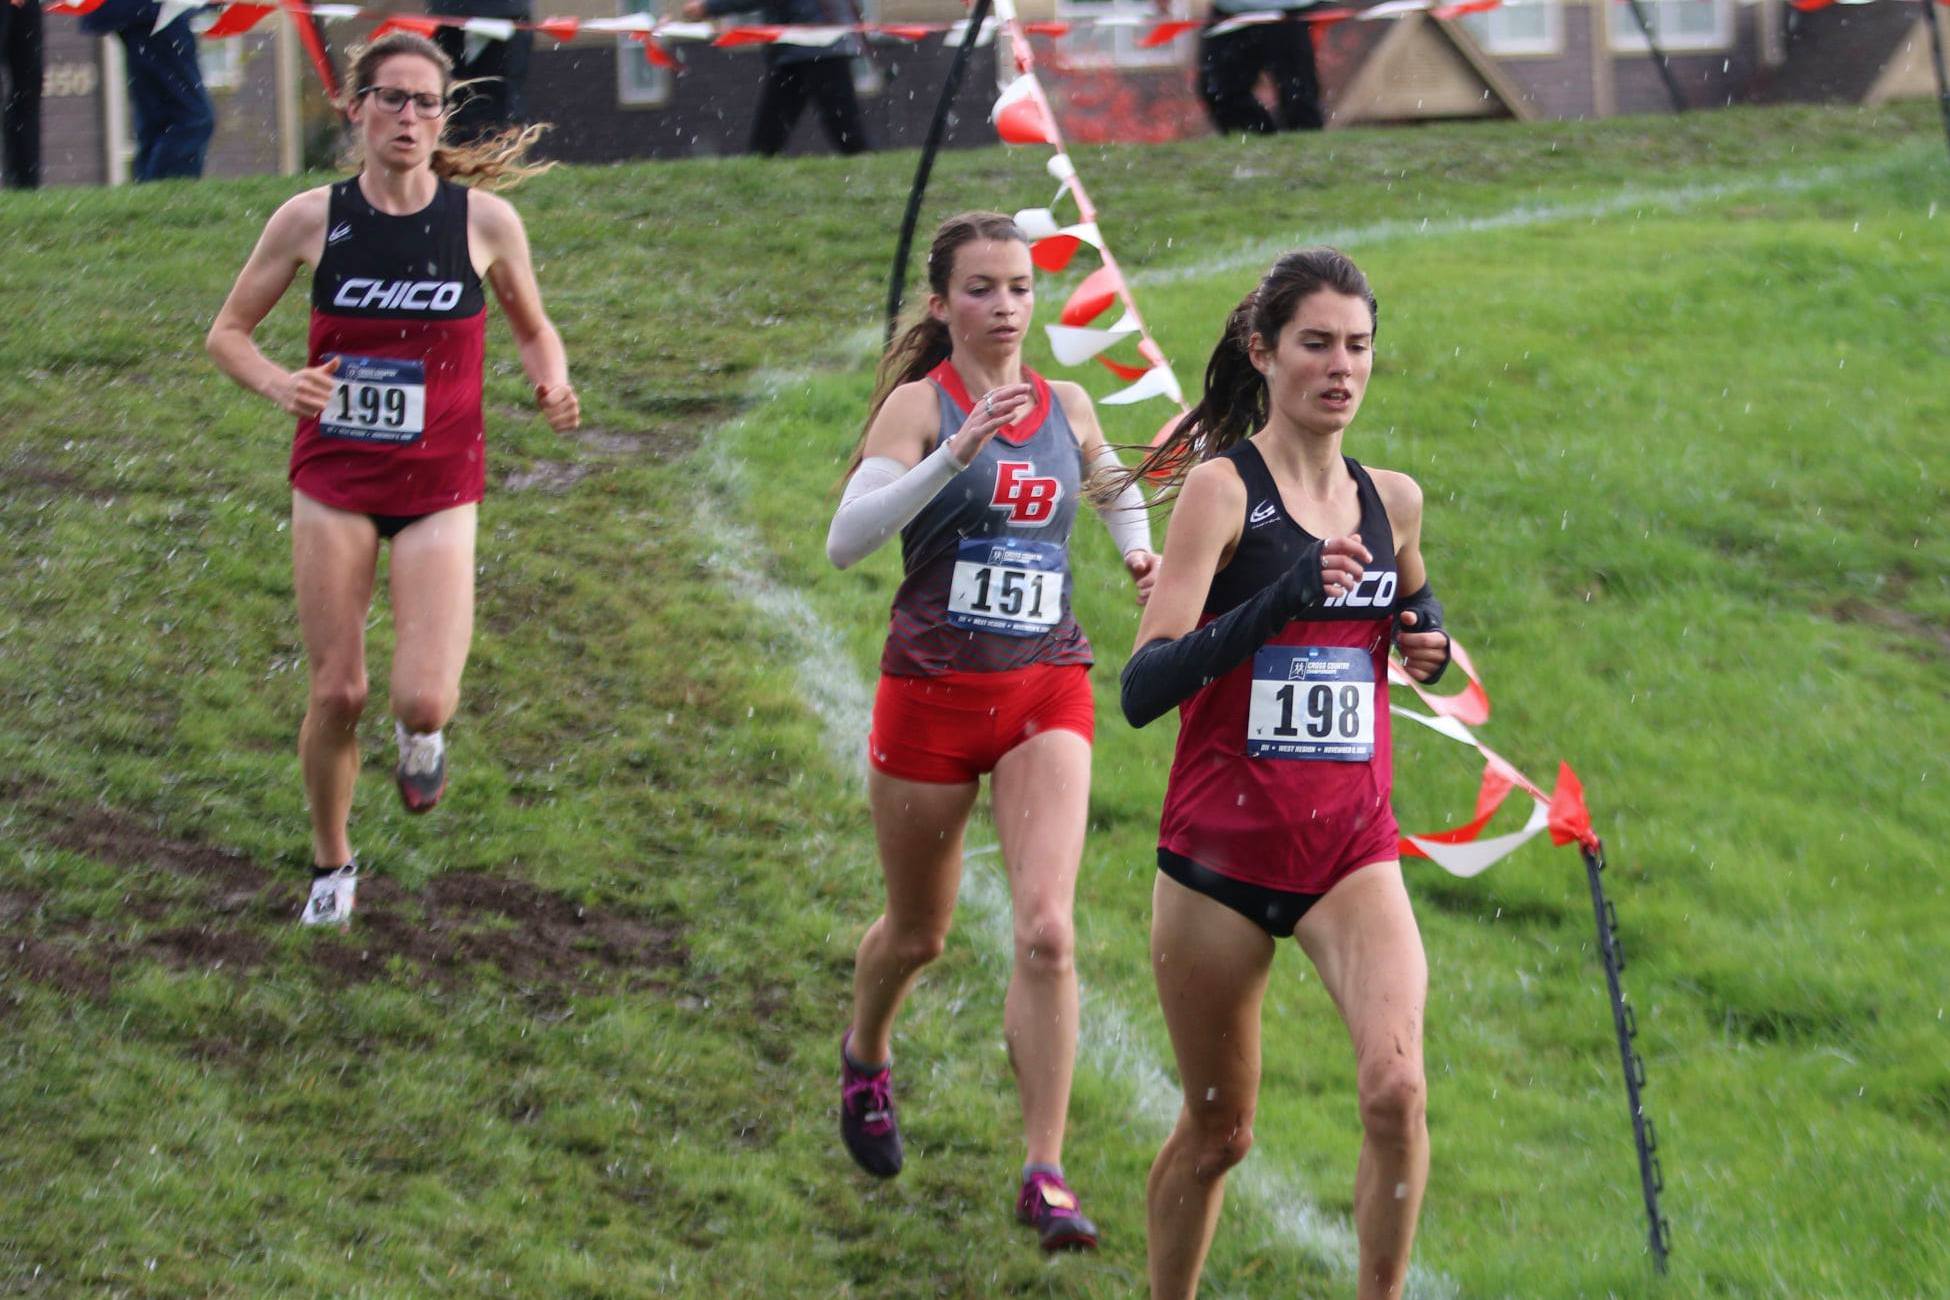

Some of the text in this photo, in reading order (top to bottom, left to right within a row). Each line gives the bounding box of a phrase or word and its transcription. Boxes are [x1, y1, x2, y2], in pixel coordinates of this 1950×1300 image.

[333, 277, 464, 311] CHICO
[336, 384, 406, 427] 199
[989, 460, 1063, 528] EB
[970, 567, 1043, 618] 151
[1273, 684, 1360, 738] 198
